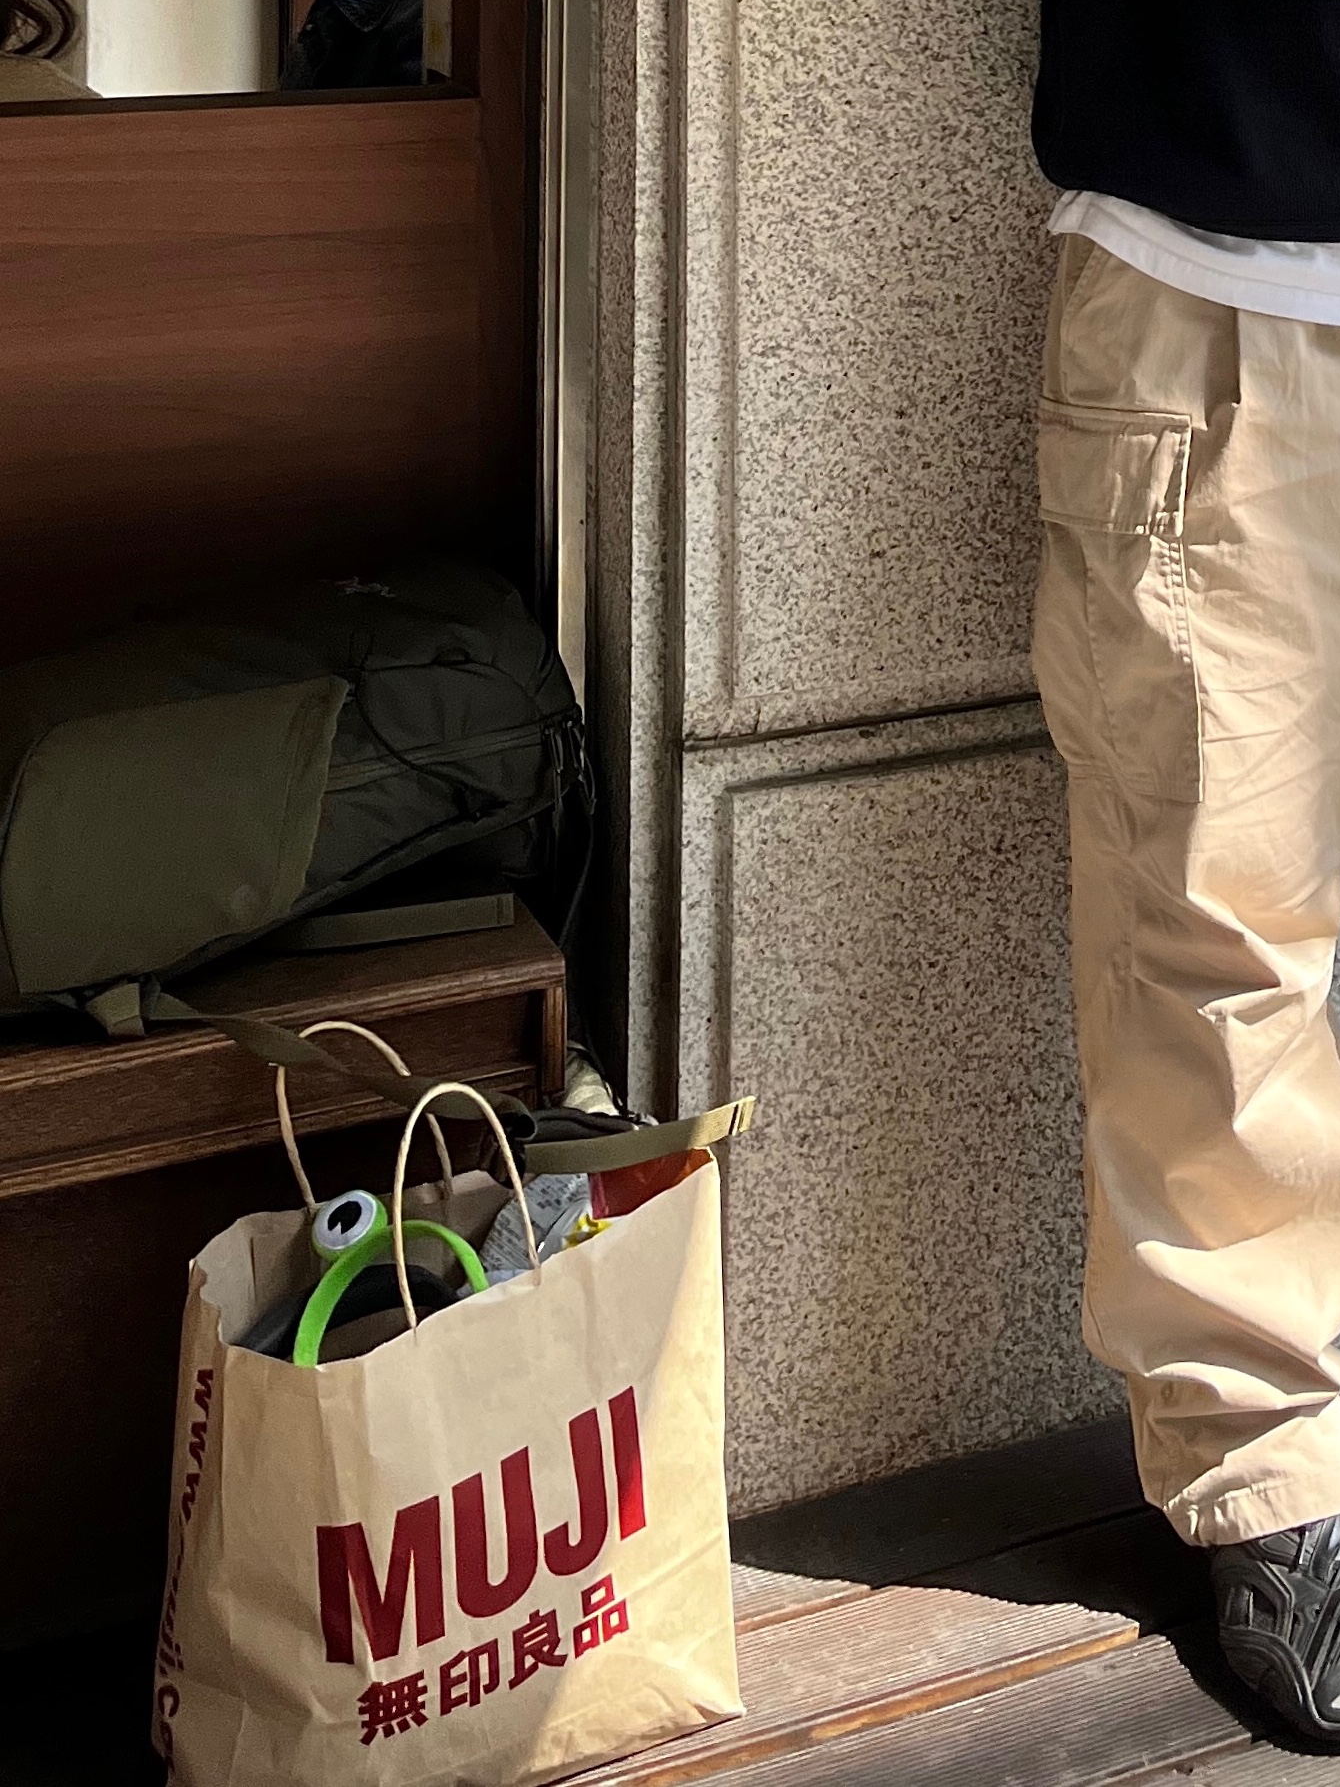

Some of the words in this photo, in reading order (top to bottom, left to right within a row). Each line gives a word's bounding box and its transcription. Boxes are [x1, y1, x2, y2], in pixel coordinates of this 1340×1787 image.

[316, 1386, 646, 1665] MUJI
[358, 1574, 630, 1744] 無印良品
